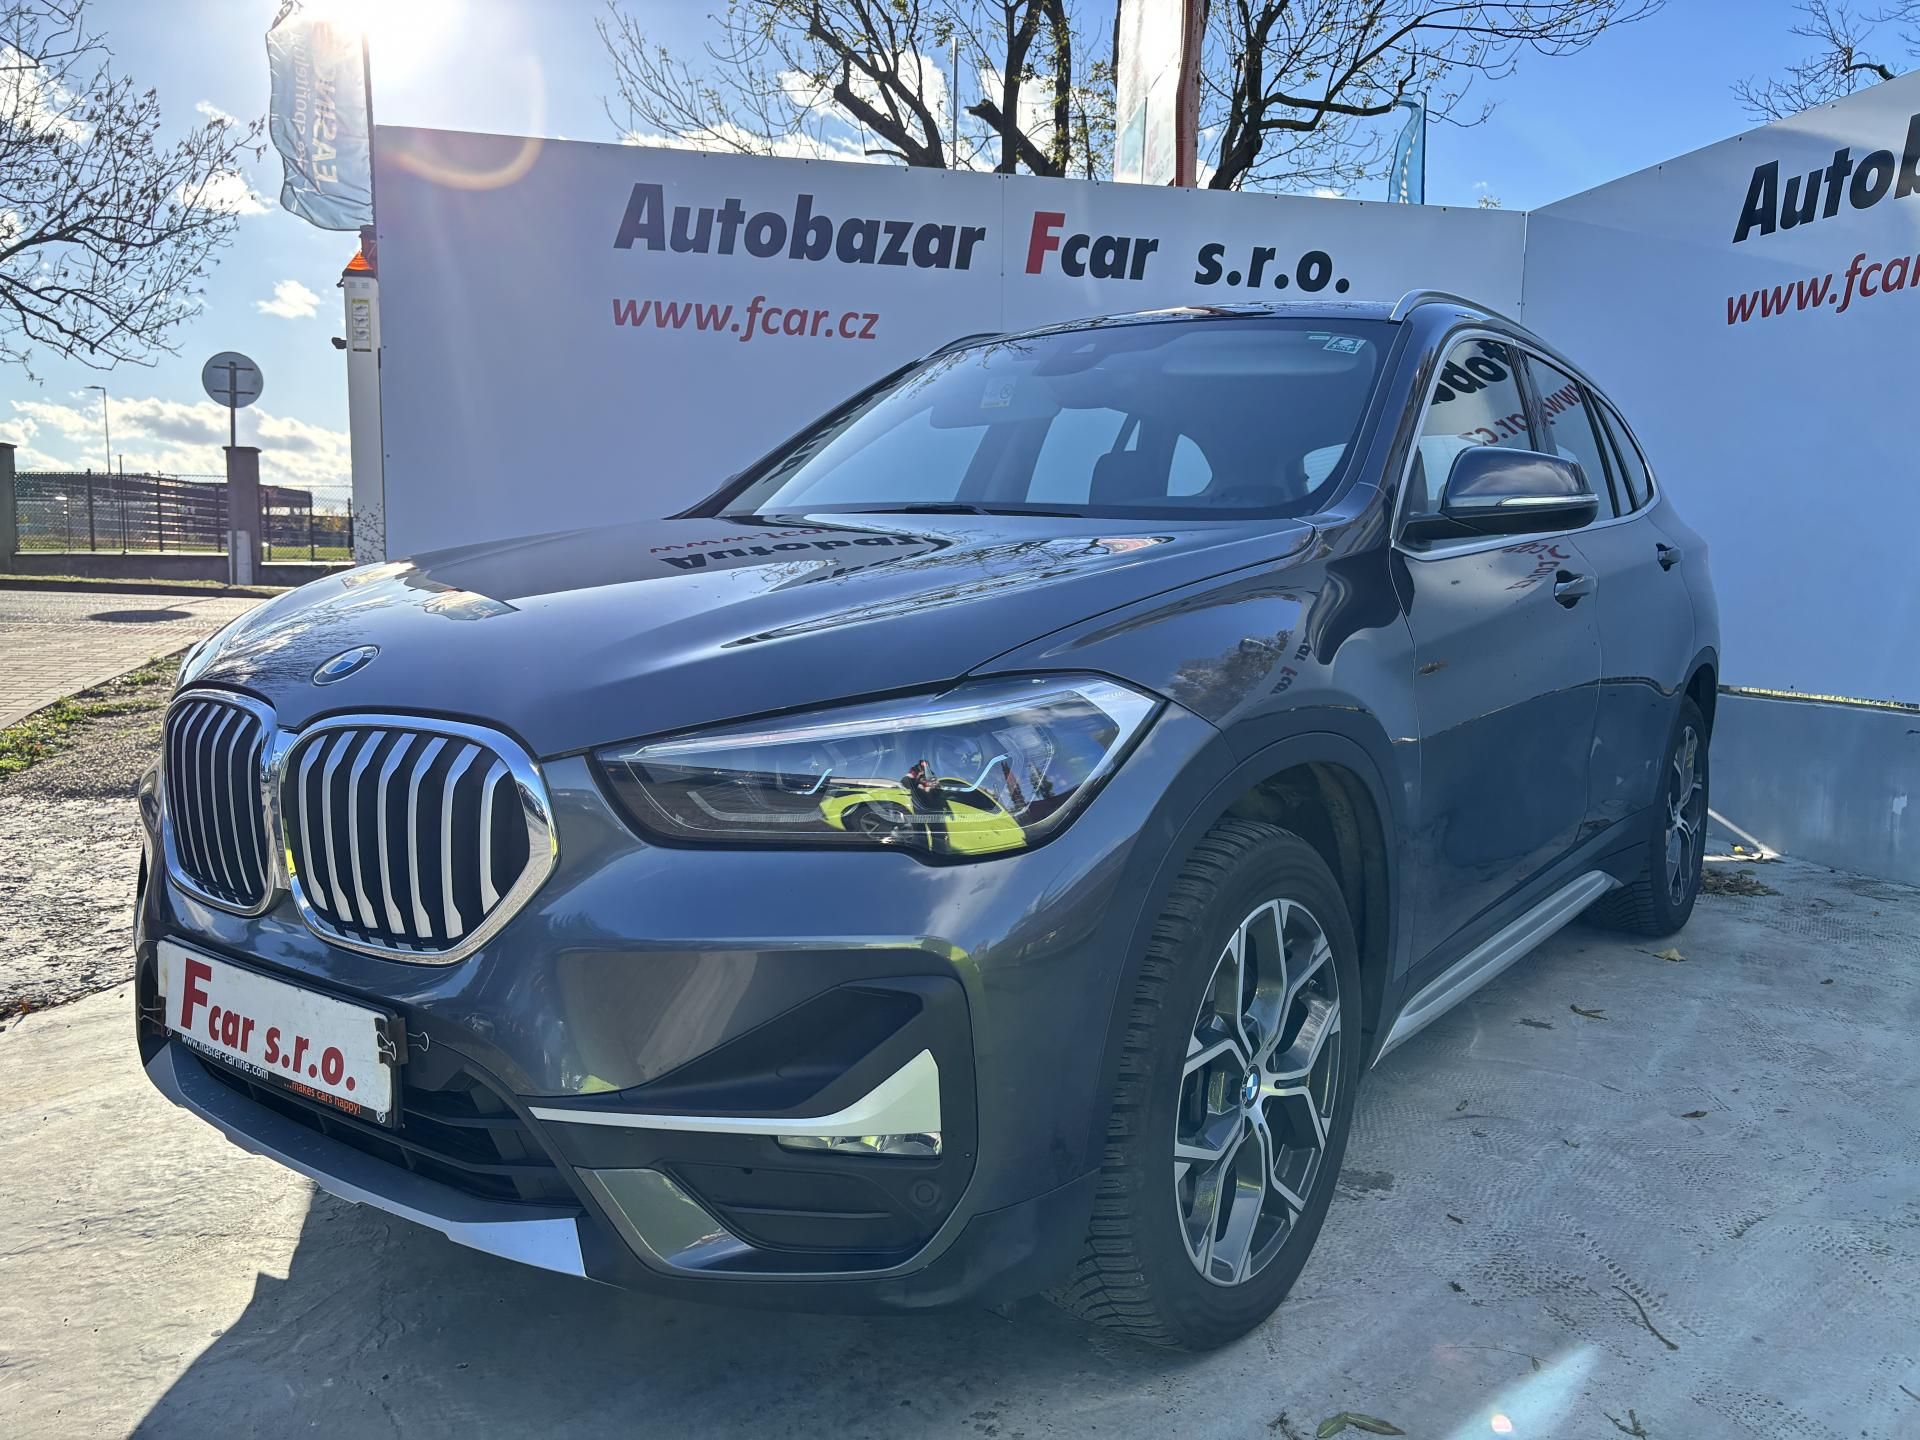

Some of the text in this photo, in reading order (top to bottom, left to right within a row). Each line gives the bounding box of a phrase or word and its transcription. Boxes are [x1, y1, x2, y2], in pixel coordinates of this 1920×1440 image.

[613, 182, 1351, 295] Autobazar Fcar s.r.o.
[612, 295, 880, 342] www.fcar.cz
[264, 1026, 356, 1092] s.r.o.
[316, 1090, 333, 1105] cars
